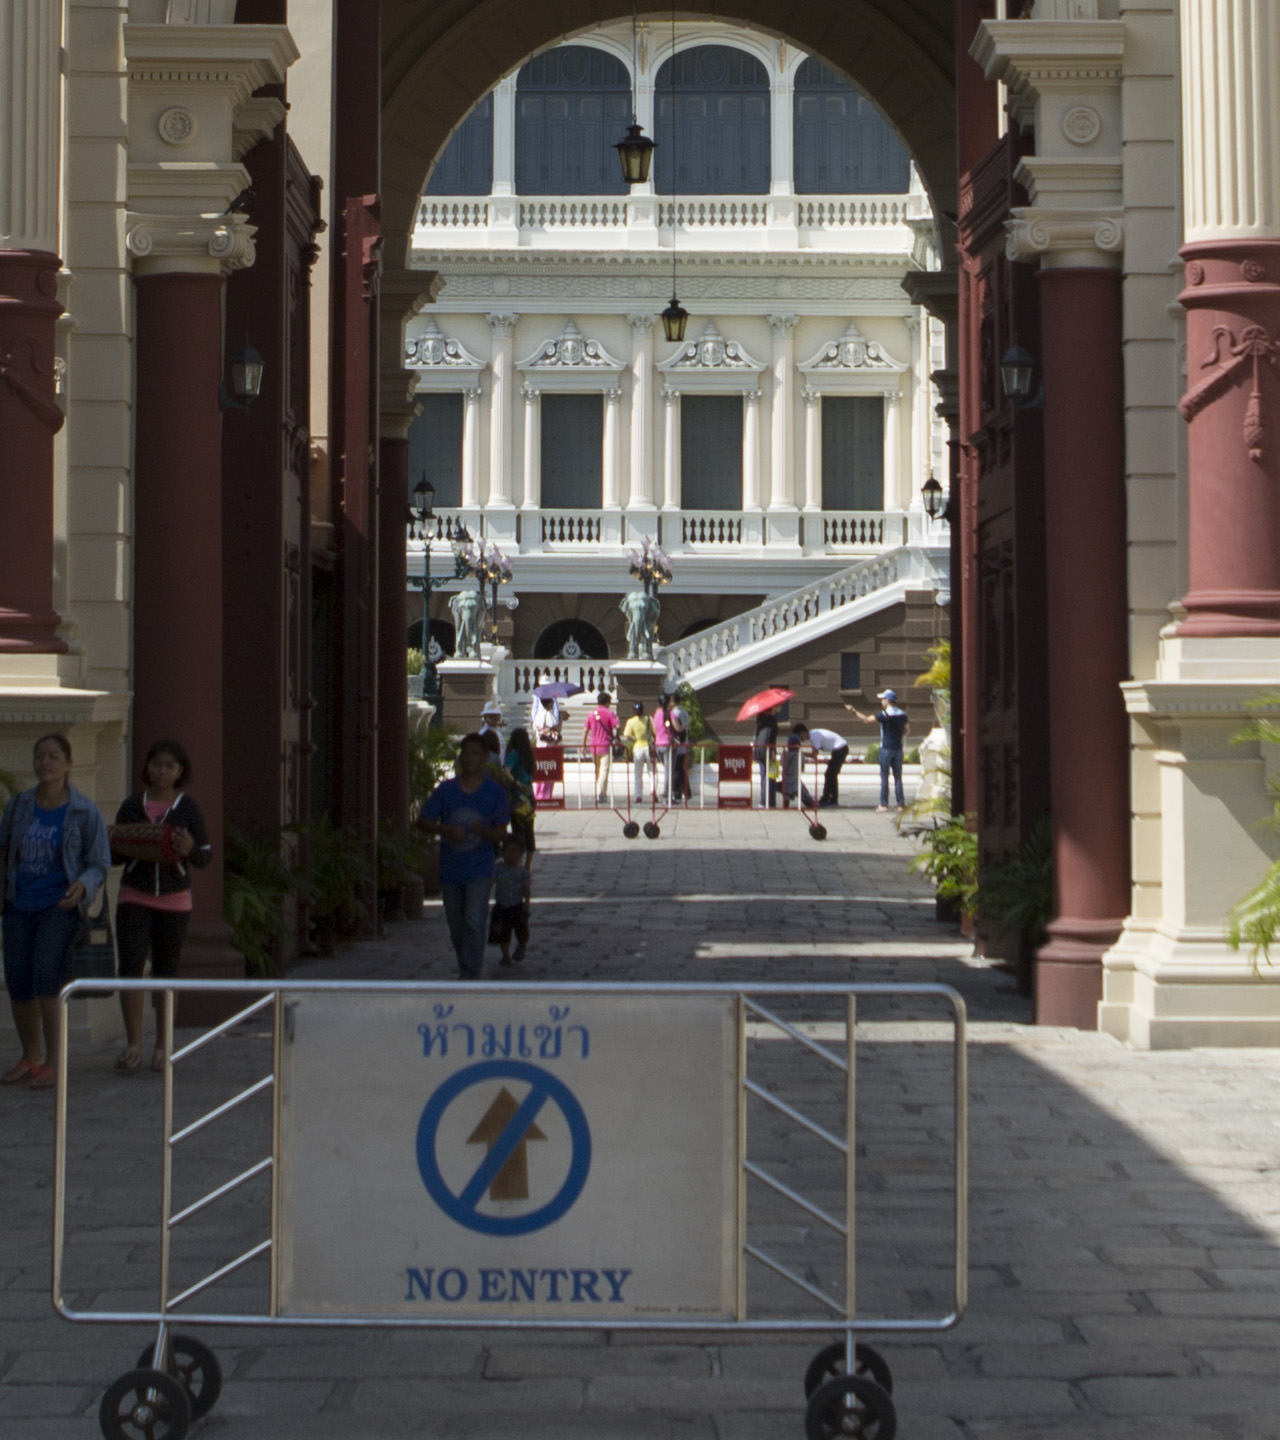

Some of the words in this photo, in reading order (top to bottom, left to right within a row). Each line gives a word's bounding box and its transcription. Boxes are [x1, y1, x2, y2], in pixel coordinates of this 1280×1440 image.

[416, 1003, 591, 1060] ห้ามเข้า
[404, 1267, 470, 1302] NO
[477, 1267, 633, 1303] ENTRY
